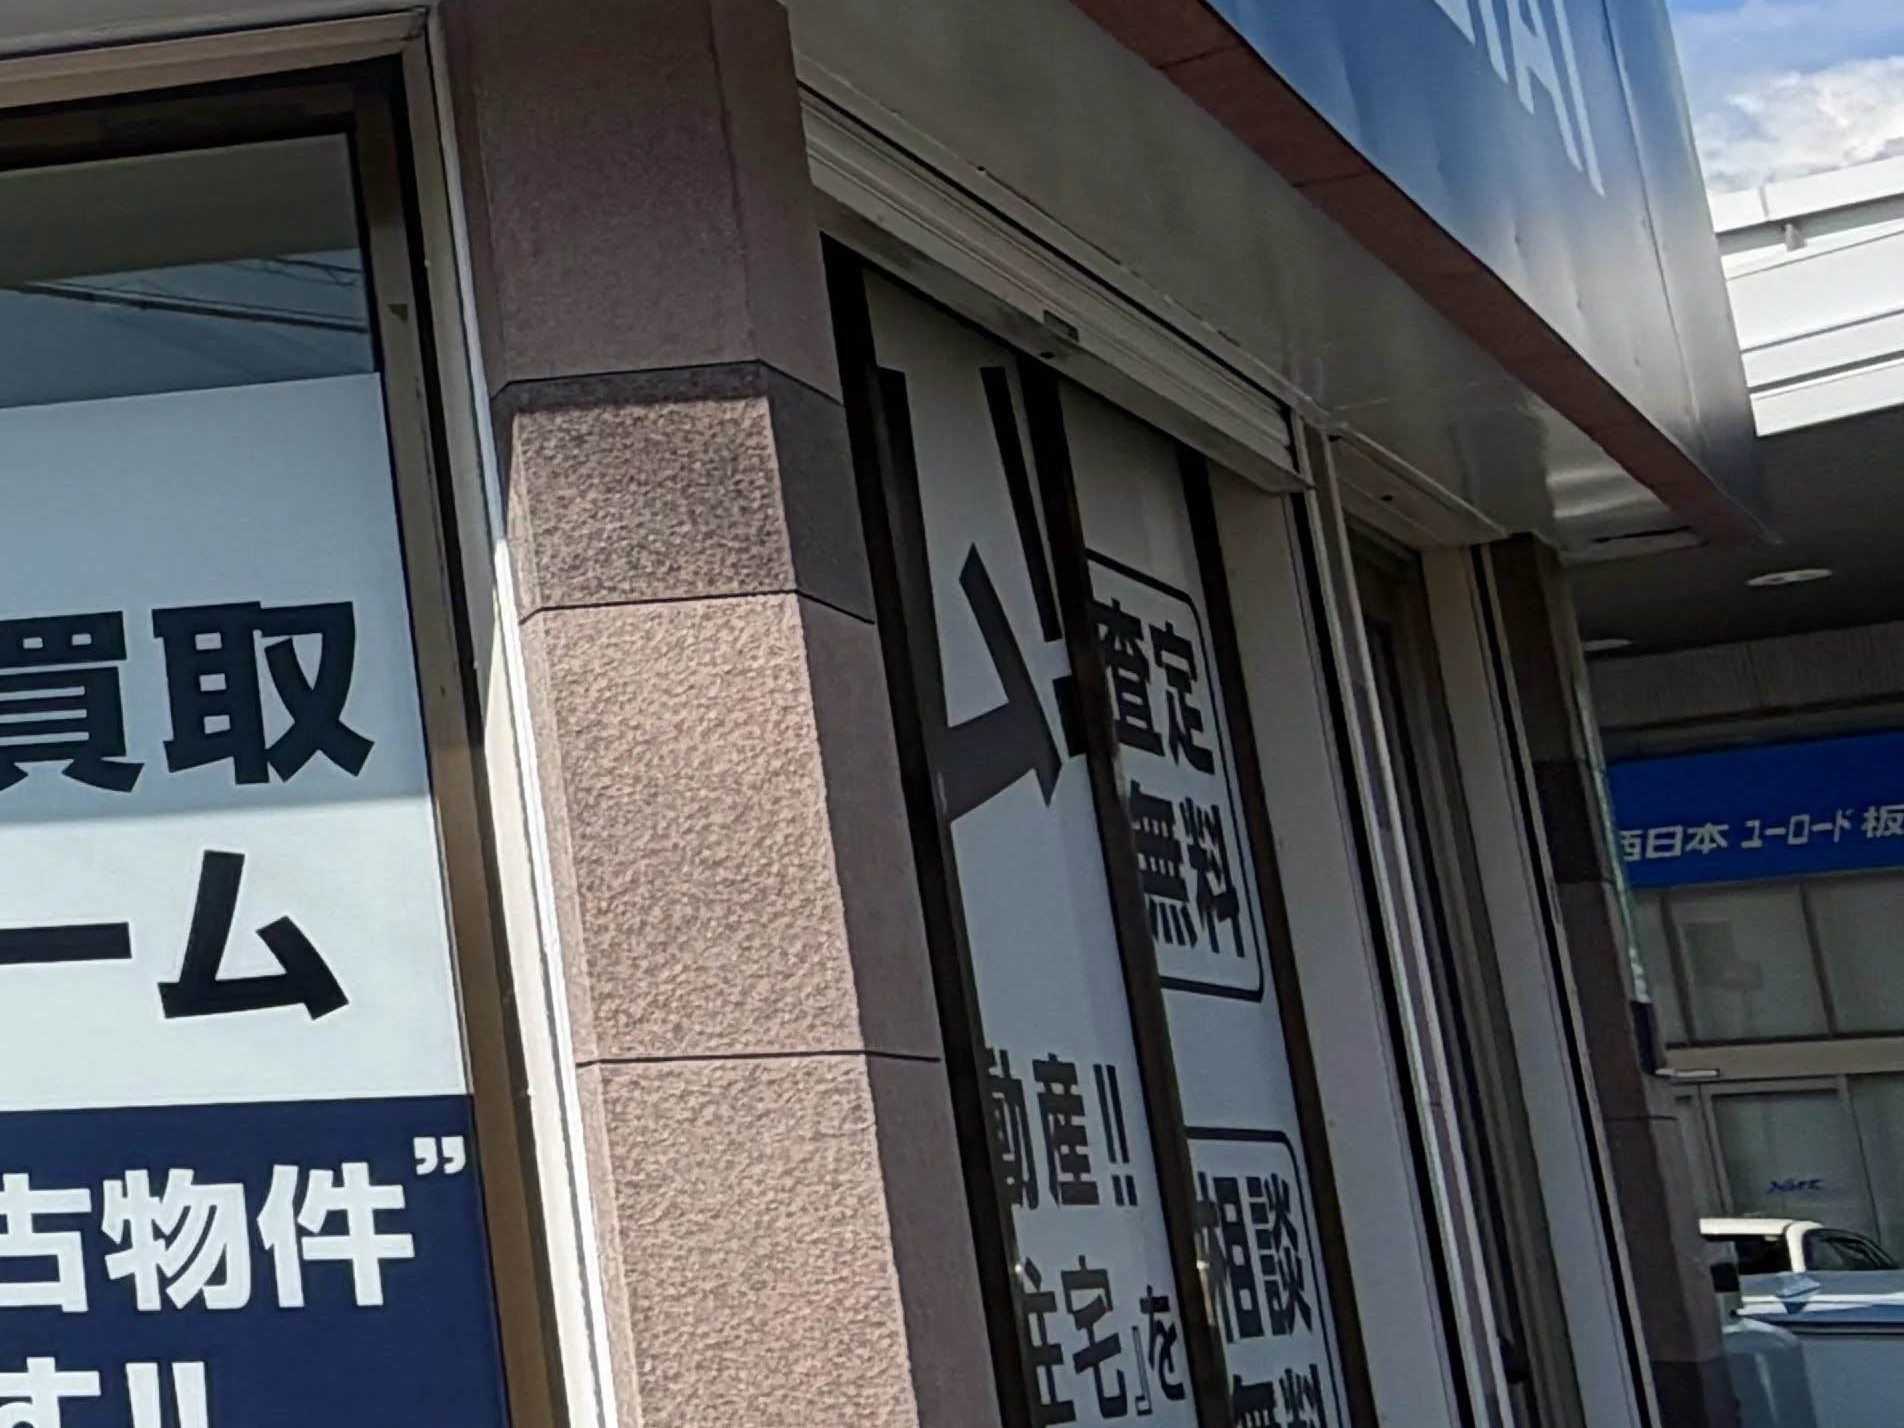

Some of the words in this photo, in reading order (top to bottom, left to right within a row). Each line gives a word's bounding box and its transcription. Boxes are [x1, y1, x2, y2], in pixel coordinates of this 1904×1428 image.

[1094, 598, 1217, 775] 査定
[1130, 778, 1246, 959] 無料
[1195, 1171, 1313, 1344] 相談
